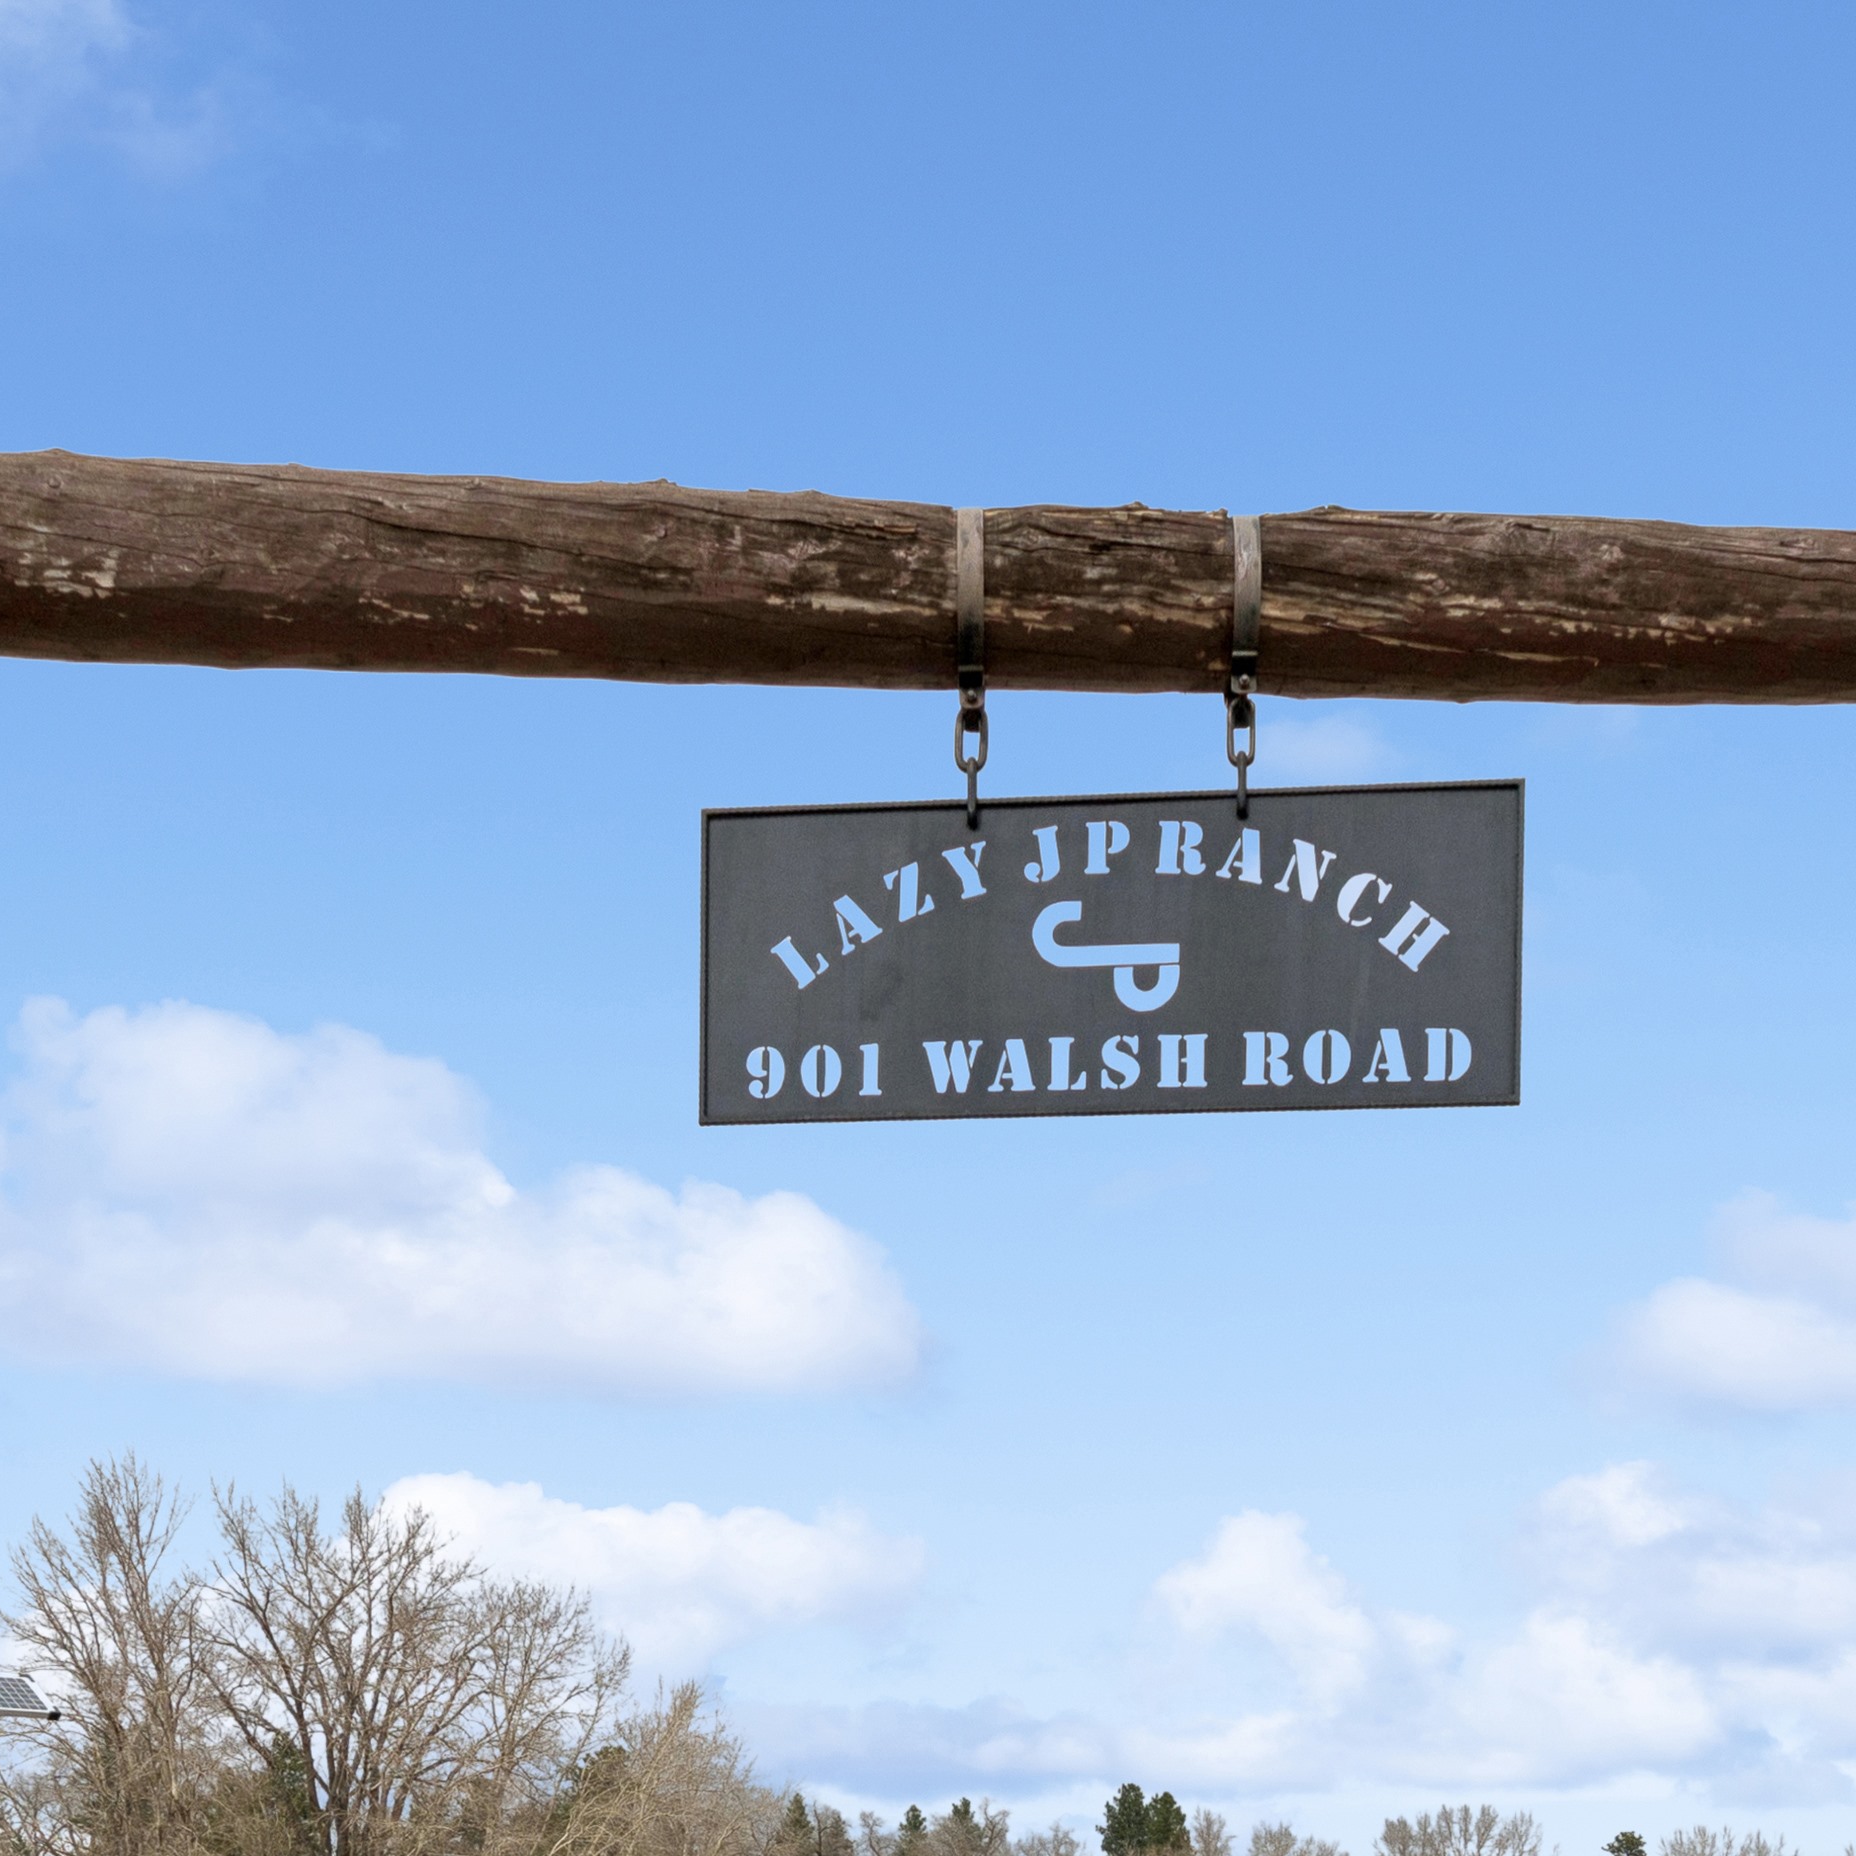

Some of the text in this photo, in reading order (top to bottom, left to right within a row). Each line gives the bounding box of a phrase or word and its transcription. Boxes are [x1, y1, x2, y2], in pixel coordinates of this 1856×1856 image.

[770, 840, 987, 990] LAZY
[1154, 820, 1450, 973] RANCH
[745, 1027, 1472, 1099] 901 WALSH ROAD
